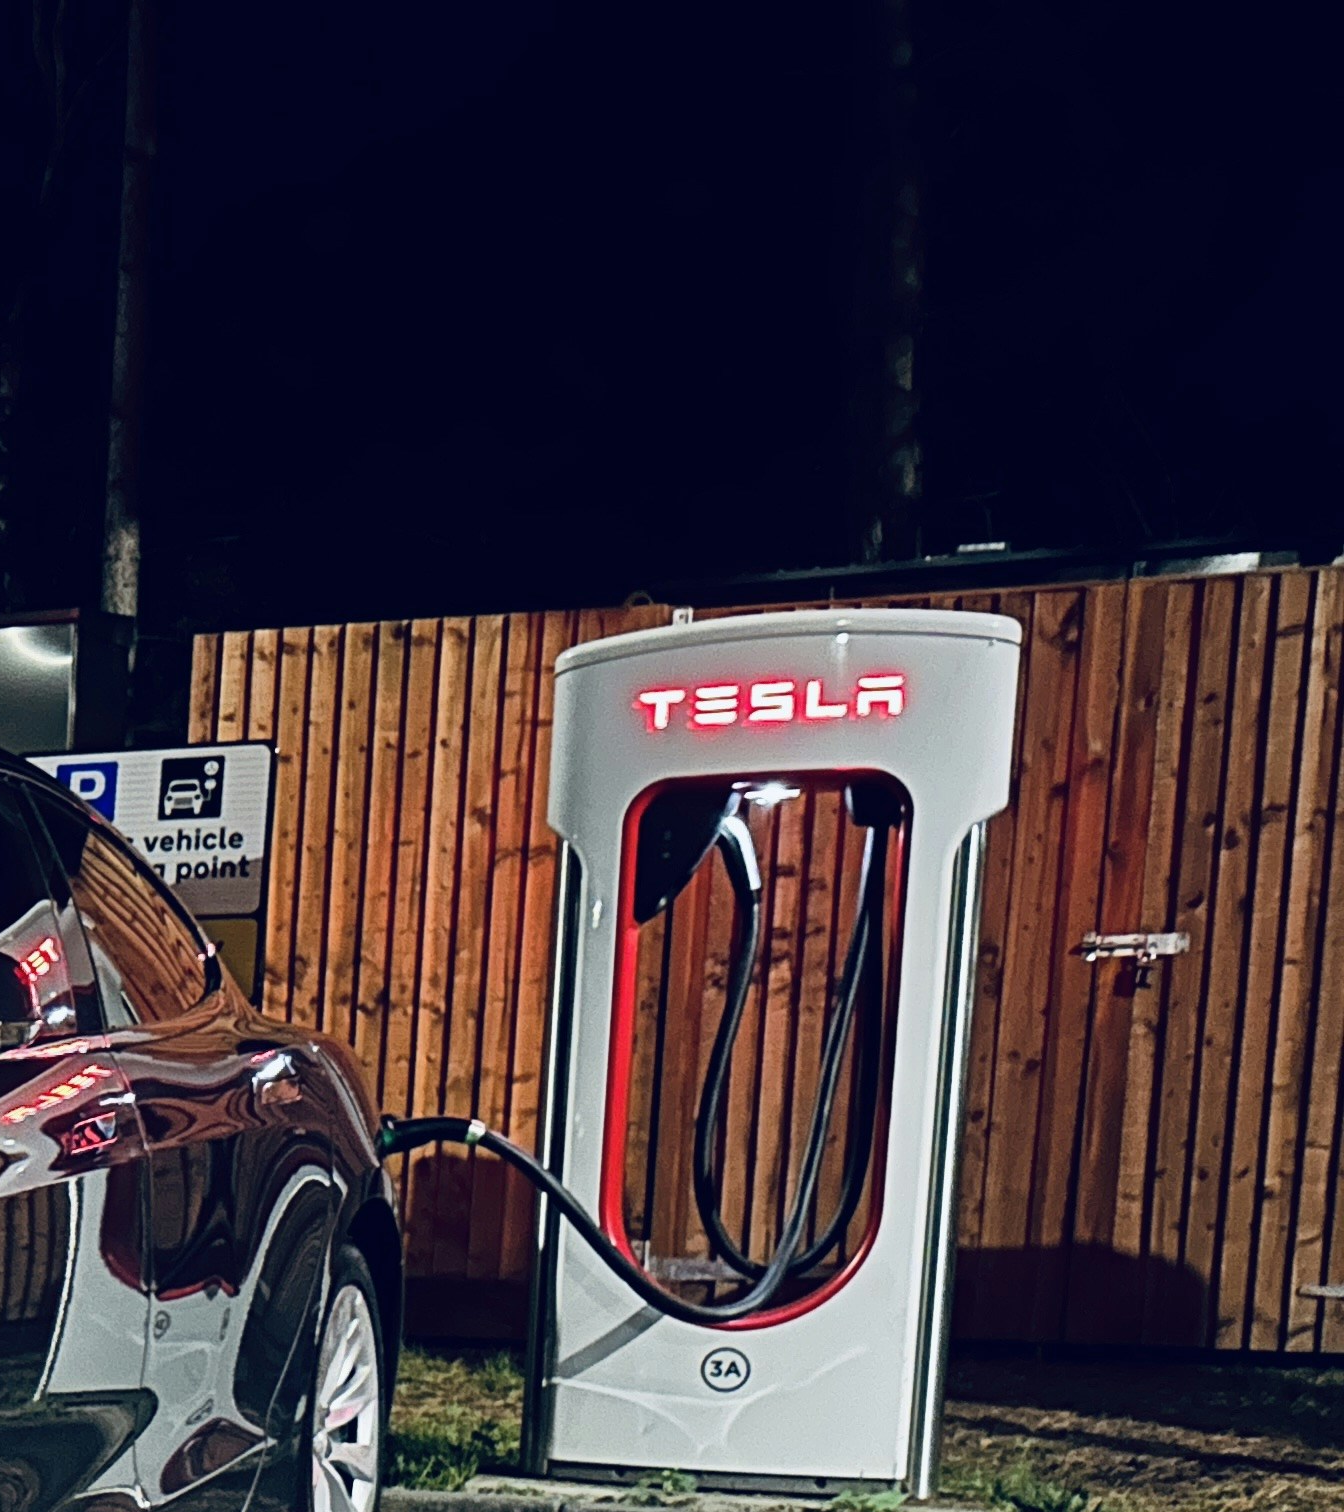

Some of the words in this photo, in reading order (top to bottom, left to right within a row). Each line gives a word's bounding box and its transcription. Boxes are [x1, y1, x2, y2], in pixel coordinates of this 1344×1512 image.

[639, 674, 905, 730] TESLA
[143, 827, 244, 854] vehicle
[175, 855, 250, 885] point
[710, 1360, 741, 1378] 3A
